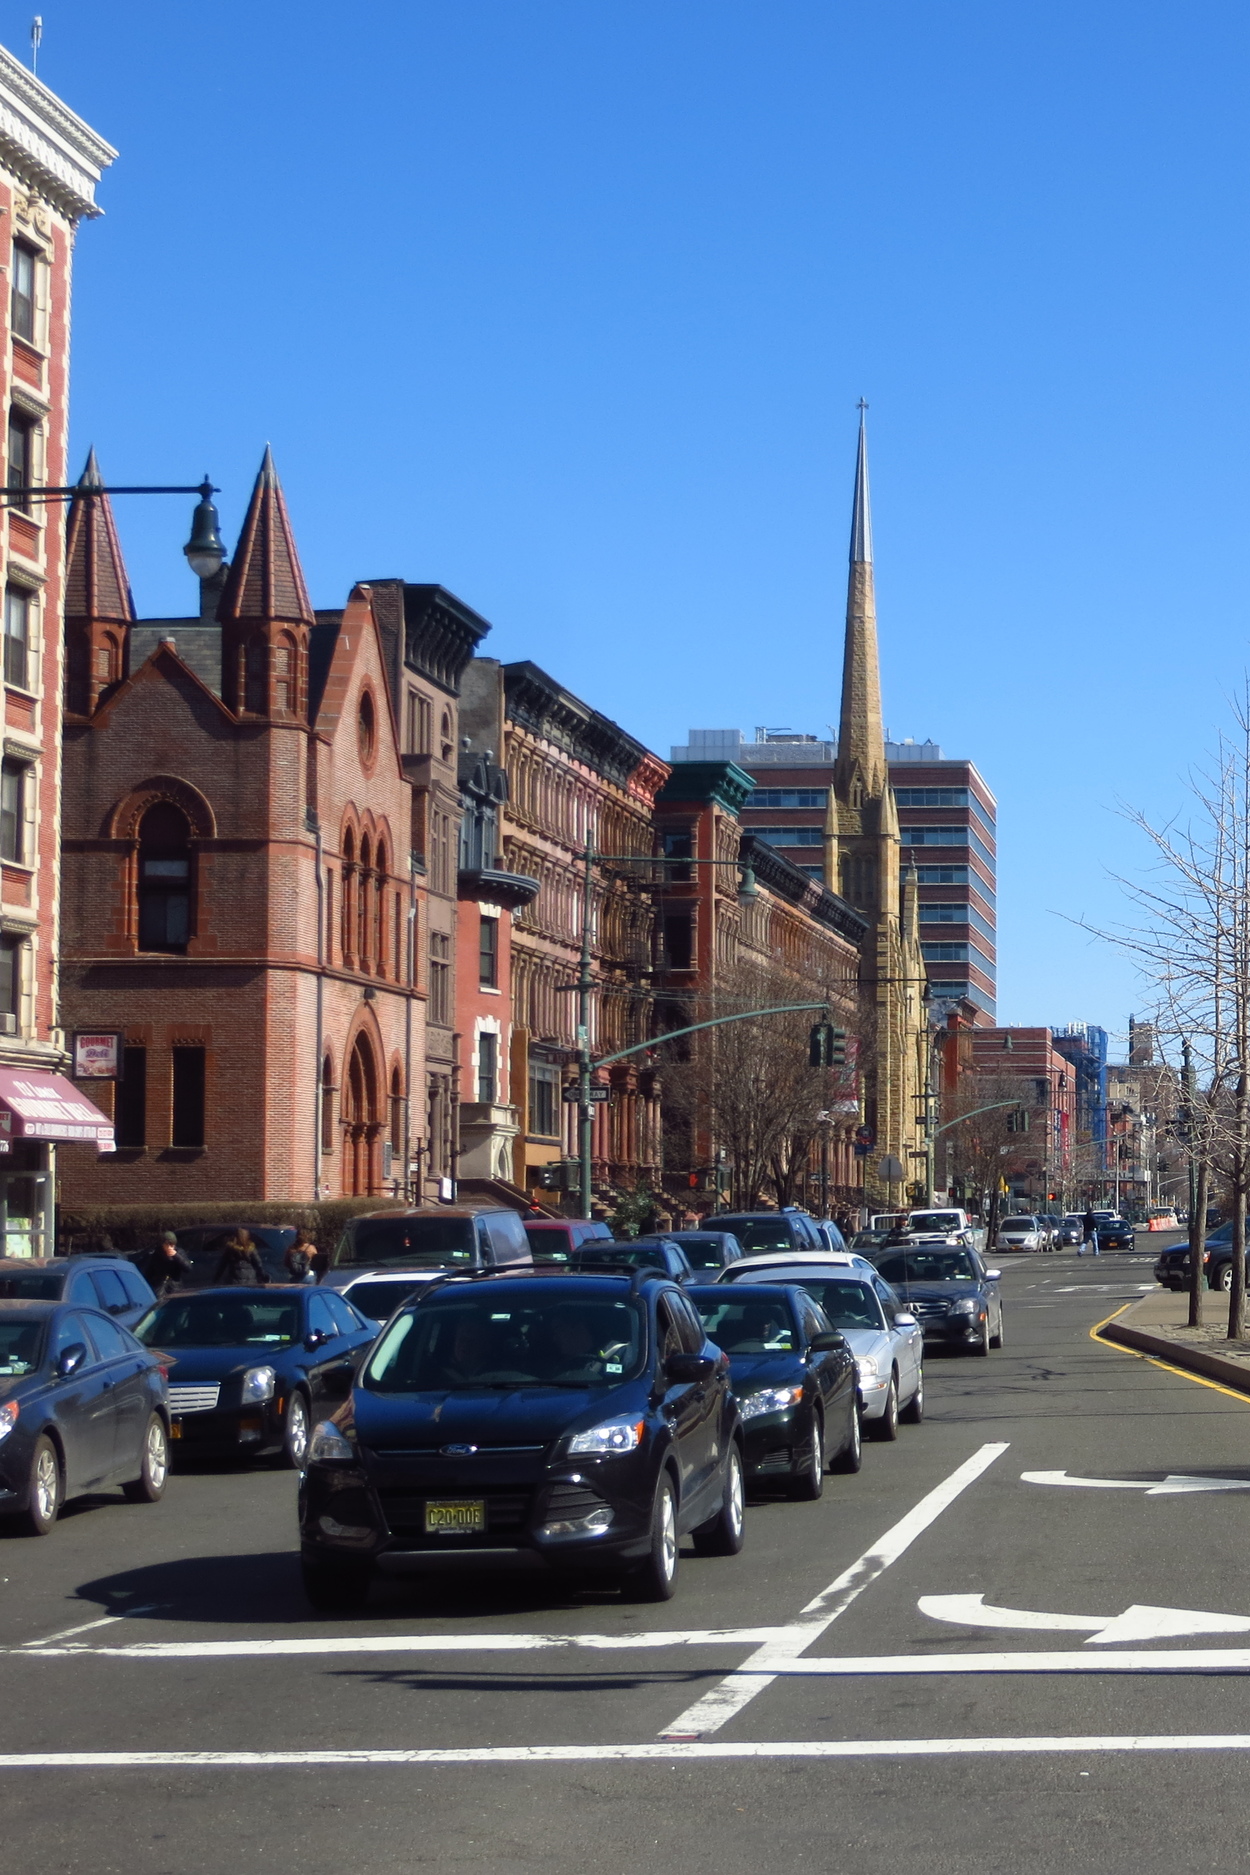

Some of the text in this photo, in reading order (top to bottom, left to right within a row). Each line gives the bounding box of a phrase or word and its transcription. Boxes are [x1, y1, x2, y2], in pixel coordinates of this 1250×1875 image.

[80, 1036, 114, 1049] GOURMET
[7, 1096, 75, 1120] GOURMET
[446, 1445, 467, 1454] Ford
